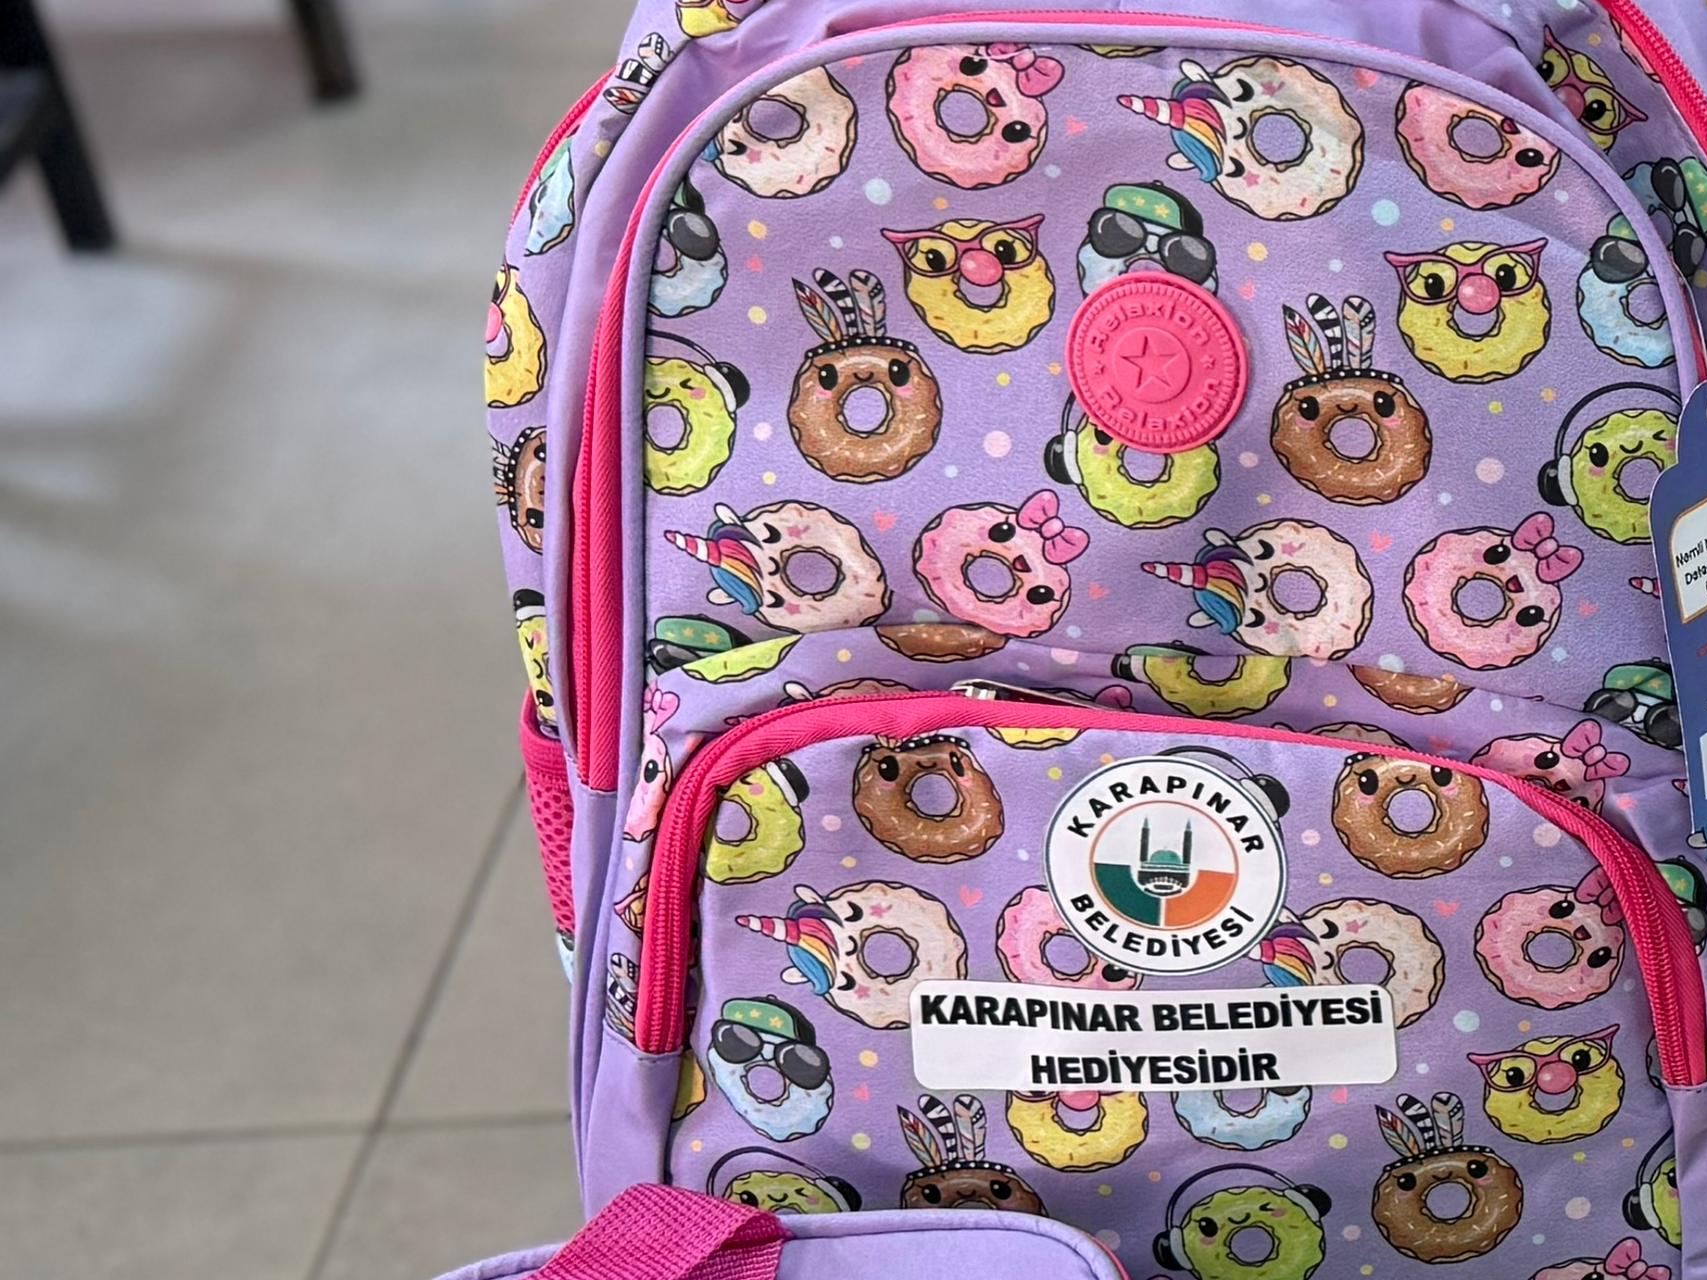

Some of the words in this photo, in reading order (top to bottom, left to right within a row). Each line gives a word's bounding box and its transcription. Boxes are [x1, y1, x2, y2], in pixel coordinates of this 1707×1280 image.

[1067, 776, 1265, 854] KARAPINAR
[1070, 894, 1255, 958] BELEDİYESİ
[921, 995, 1142, 1032] KARAPINAR
[1154, 991, 1383, 1031] BELEDİYESİ
[1031, 1048, 1279, 1085] HEDİYESİDİR
